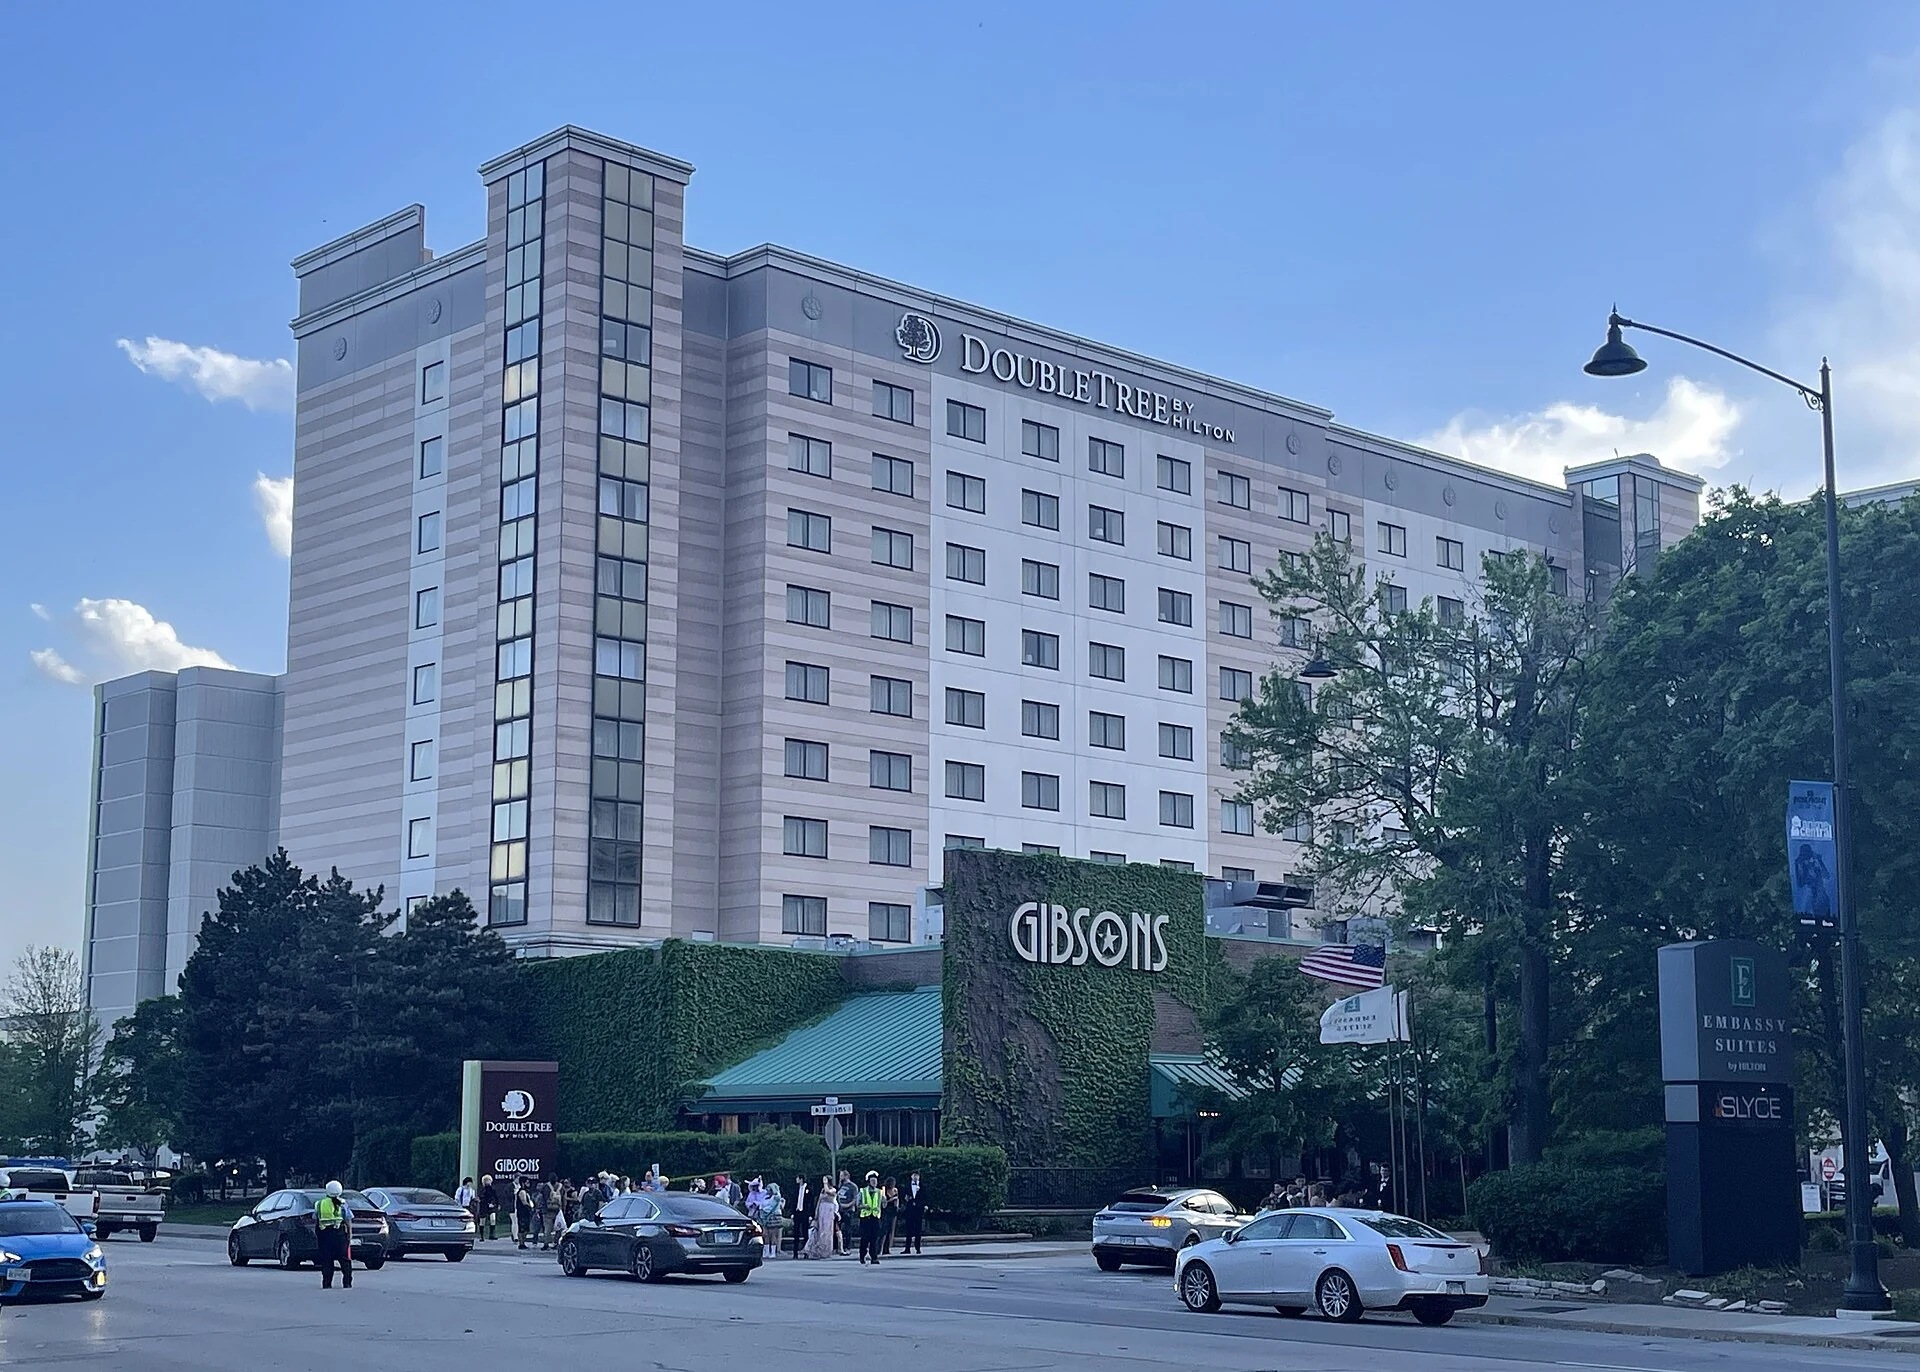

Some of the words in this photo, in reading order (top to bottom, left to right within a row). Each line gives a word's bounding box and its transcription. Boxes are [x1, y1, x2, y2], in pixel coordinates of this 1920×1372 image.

[961, 333, 1170, 425] DOUBLETREE
[1171, 398, 1194, 416] BY
[1172, 414, 1236, 443] HILTON
[1011, 902, 1169, 972] GIBSONS
[1703, 1015, 1786, 1032] EMBASSY
[1715, 1039, 1777, 1054] SUITES
[1728, 1062, 1737, 1072] by
[1738, 1062, 1767, 1072] HILTON
[1720, 1096, 1782, 1119] SLYCE
[486, 1122, 552, 1131] DOUBLETREE
[494, 1159, 540, 1172] GIBSONS
